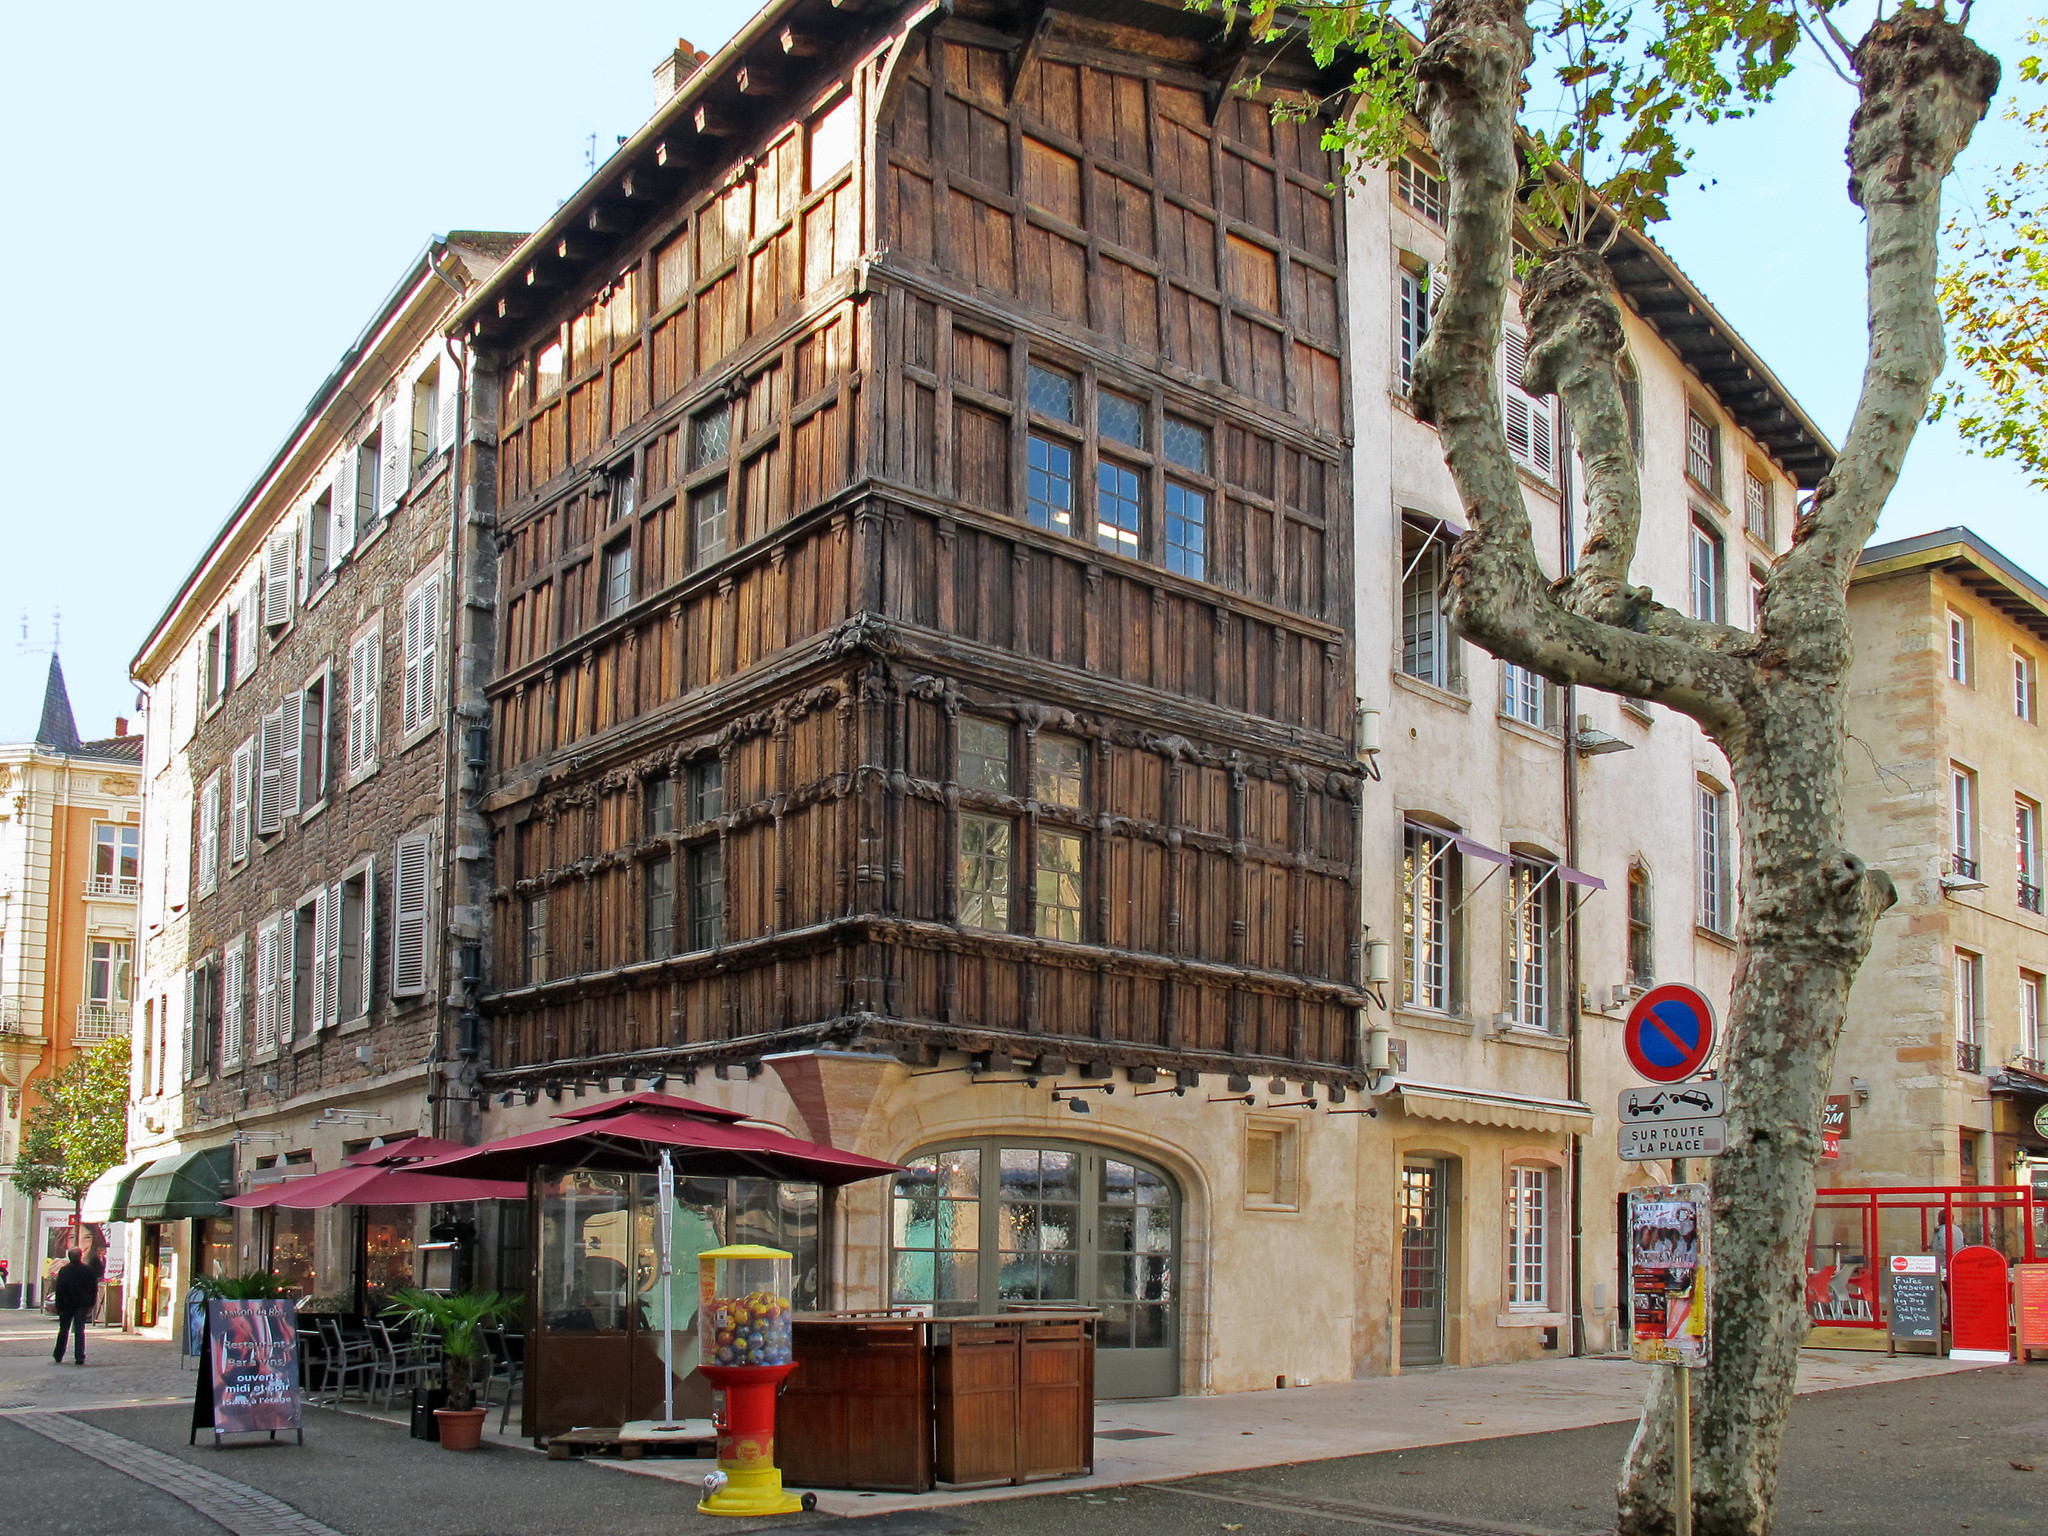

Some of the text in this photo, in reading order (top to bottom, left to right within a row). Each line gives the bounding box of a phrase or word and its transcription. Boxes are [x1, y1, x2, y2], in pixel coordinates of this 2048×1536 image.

[1631, 1126, 1704, 1141] SUR TOUTE
[1640, 1143, 1654, 1153] LA
[1660, 1140, 1700, 1152] PLACE
[219, 1308, 253, 1319] Maison
[224, 1340, 286, 1350] Restaurant
[228, 1358, 248, 1367] Bar
[237, 1372, 275, 1382] ouvert
[225, 1383, 251, 1393] midi
